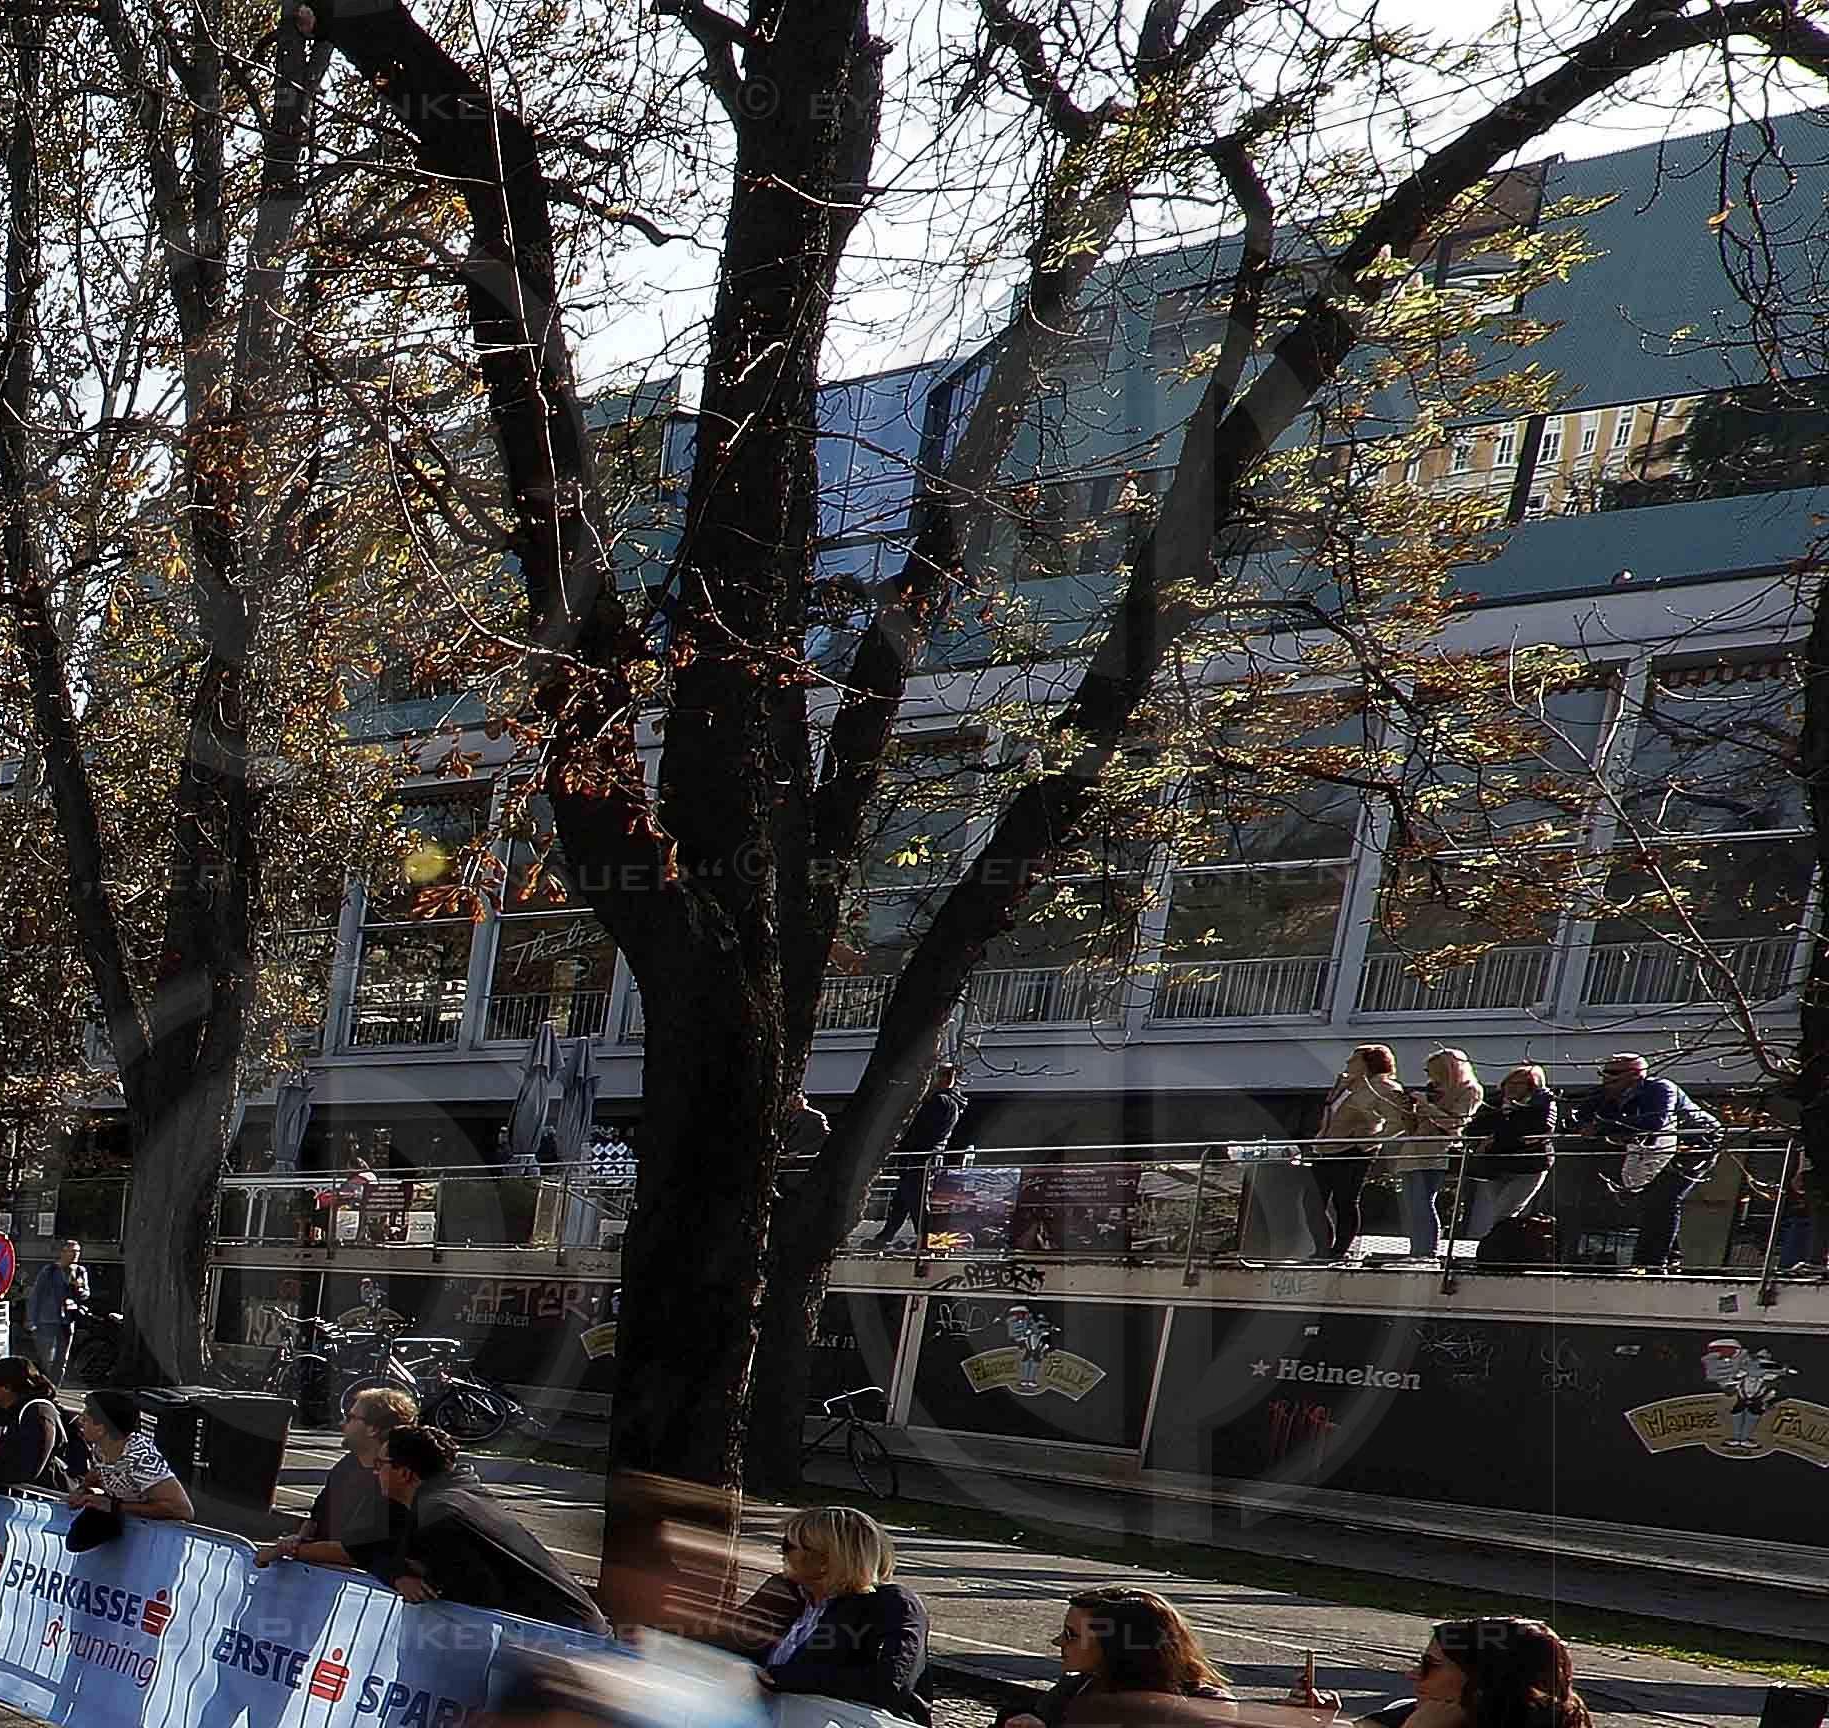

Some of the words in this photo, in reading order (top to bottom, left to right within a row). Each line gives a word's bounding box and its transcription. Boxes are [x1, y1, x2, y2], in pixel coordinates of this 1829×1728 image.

[506, 919, 609, 976] Thalia
[1275, 1357, 1422, 1391] Heineken
[3, 1558, 143, 1630] SPARKASSE
[66, 1629, 158, 1689] running
[212, 1627, 310, 1690] ERSTE
